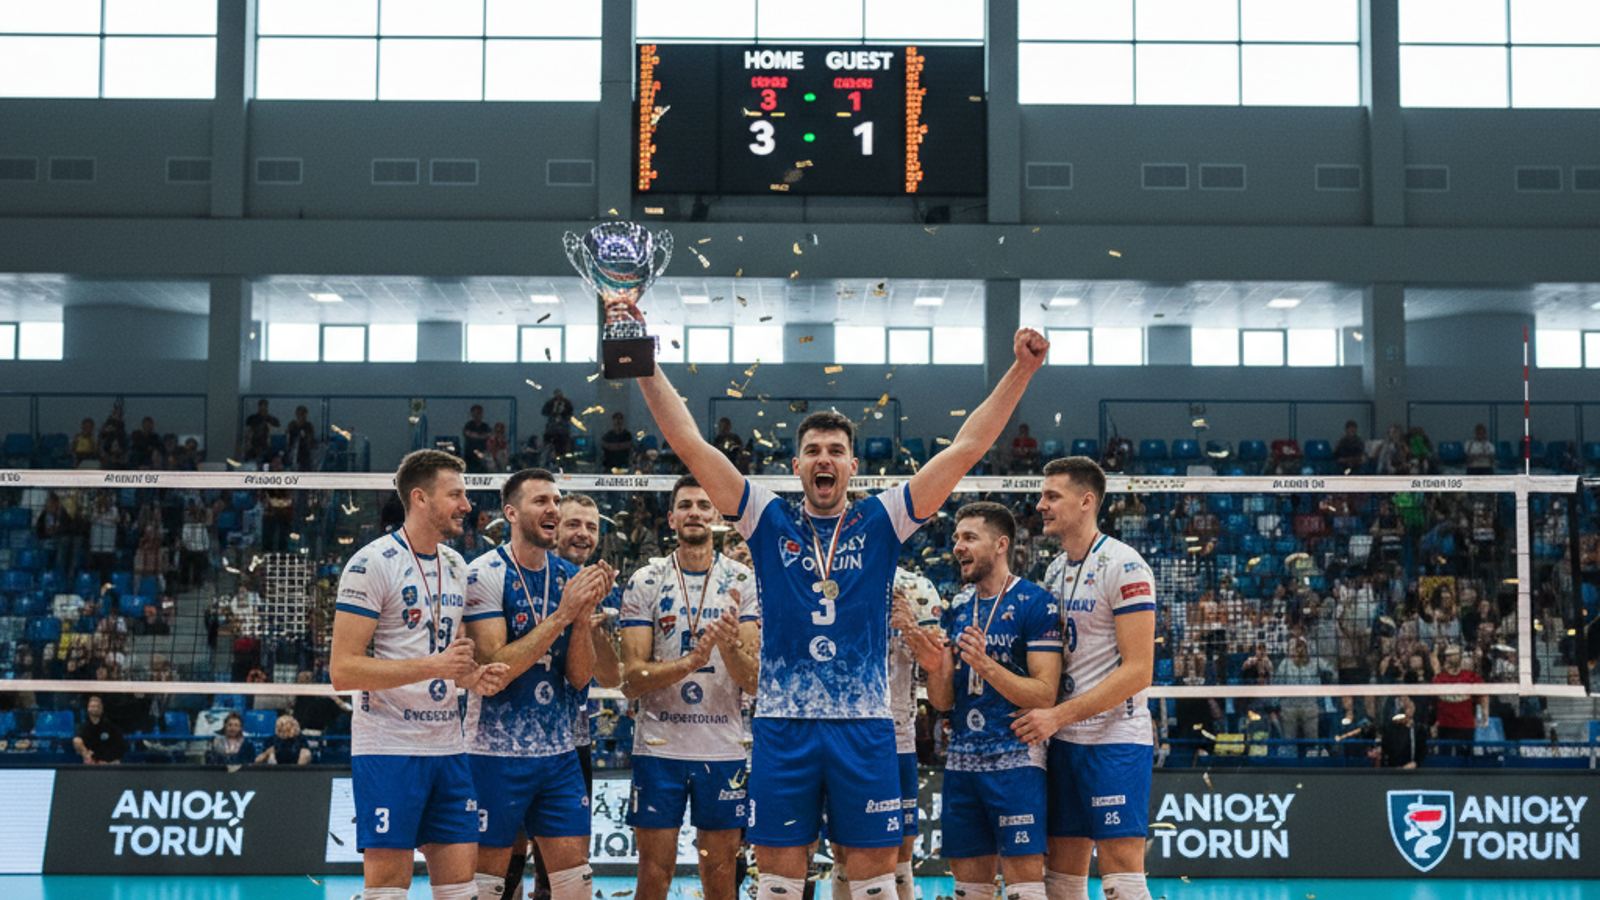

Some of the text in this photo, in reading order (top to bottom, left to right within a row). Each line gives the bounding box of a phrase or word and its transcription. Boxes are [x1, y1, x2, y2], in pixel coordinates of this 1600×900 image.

[744, 50, 894, 70] HOME GUEST
[760, 89, 861, 111] 3 1
[748, 120, 874, 156] 3 1
[111, 790, 256, 820] ANIOŁY
[1155, 793, 1295, 824] ANIOŁY
[1459, 795, 1588, 824] ANIOŁY
[375, 807, 390, 834] 3
[109, 817, 244, 856] TORUŃ
[1154, 823, 1290, 859] TORUŃ
[1457, 823, 1580, 860] TORUŃ
